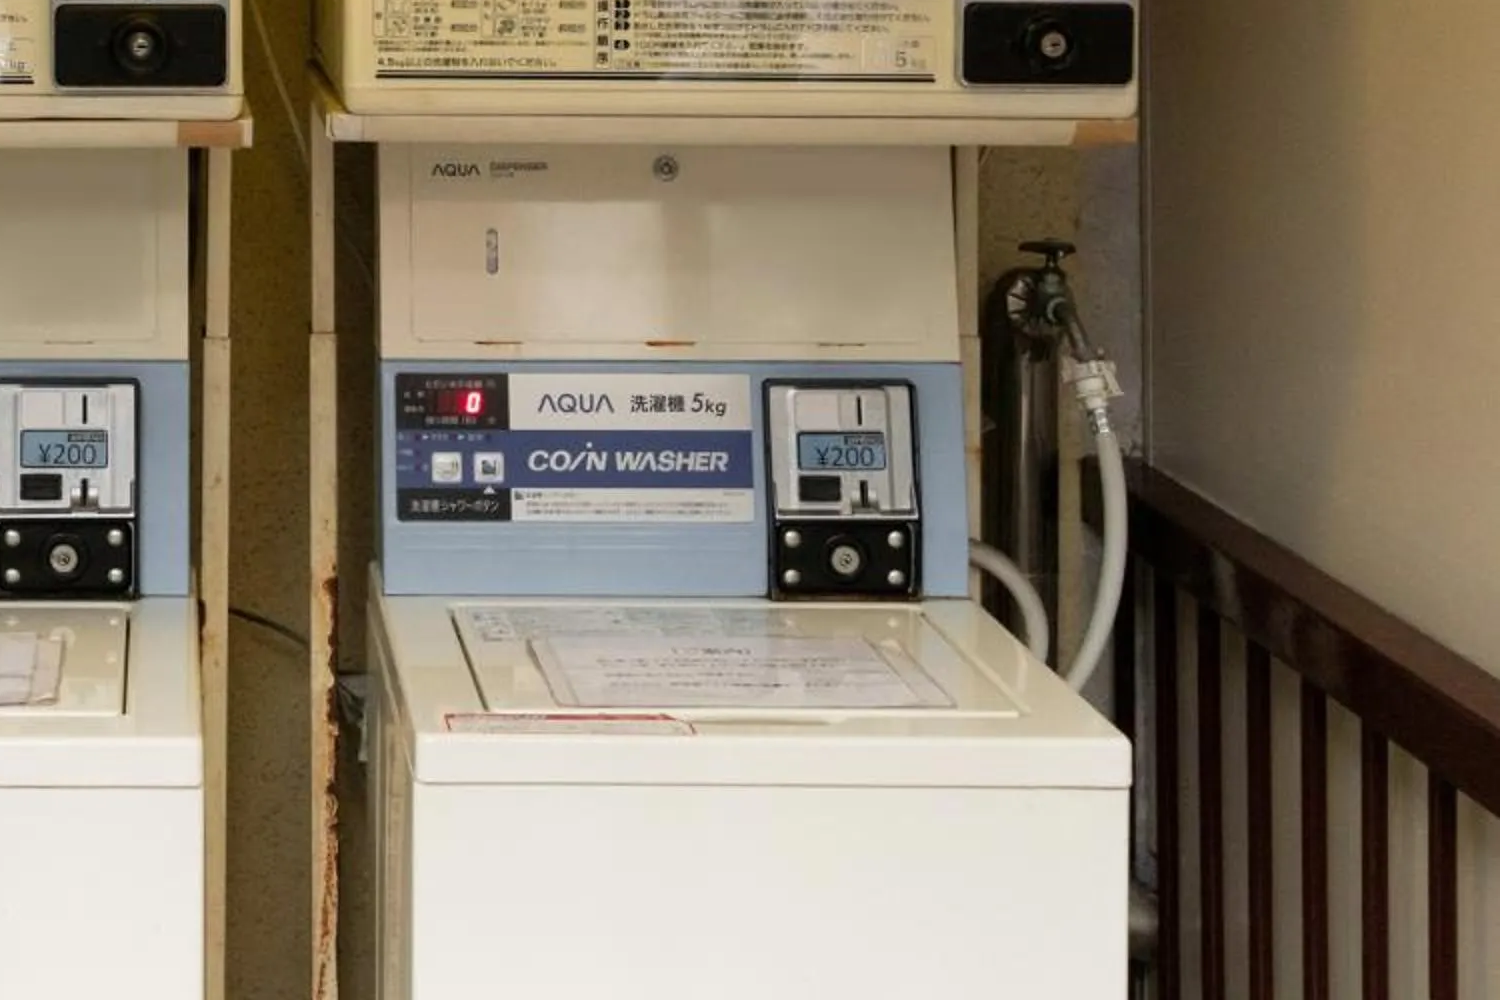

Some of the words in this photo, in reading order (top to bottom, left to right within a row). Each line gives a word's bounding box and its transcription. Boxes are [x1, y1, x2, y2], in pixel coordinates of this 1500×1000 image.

[431, 163, 480, 177] AQUA
[465, 391, 481, 413] 0
[538, 393, 615, 413] AQUA
[630, 394, 685, 412] 洗濯機
[691, 392, 727, 416] 5kg
[615, 451, 729, 472] WASHER
[816, 446, 874, 467] ¥200
